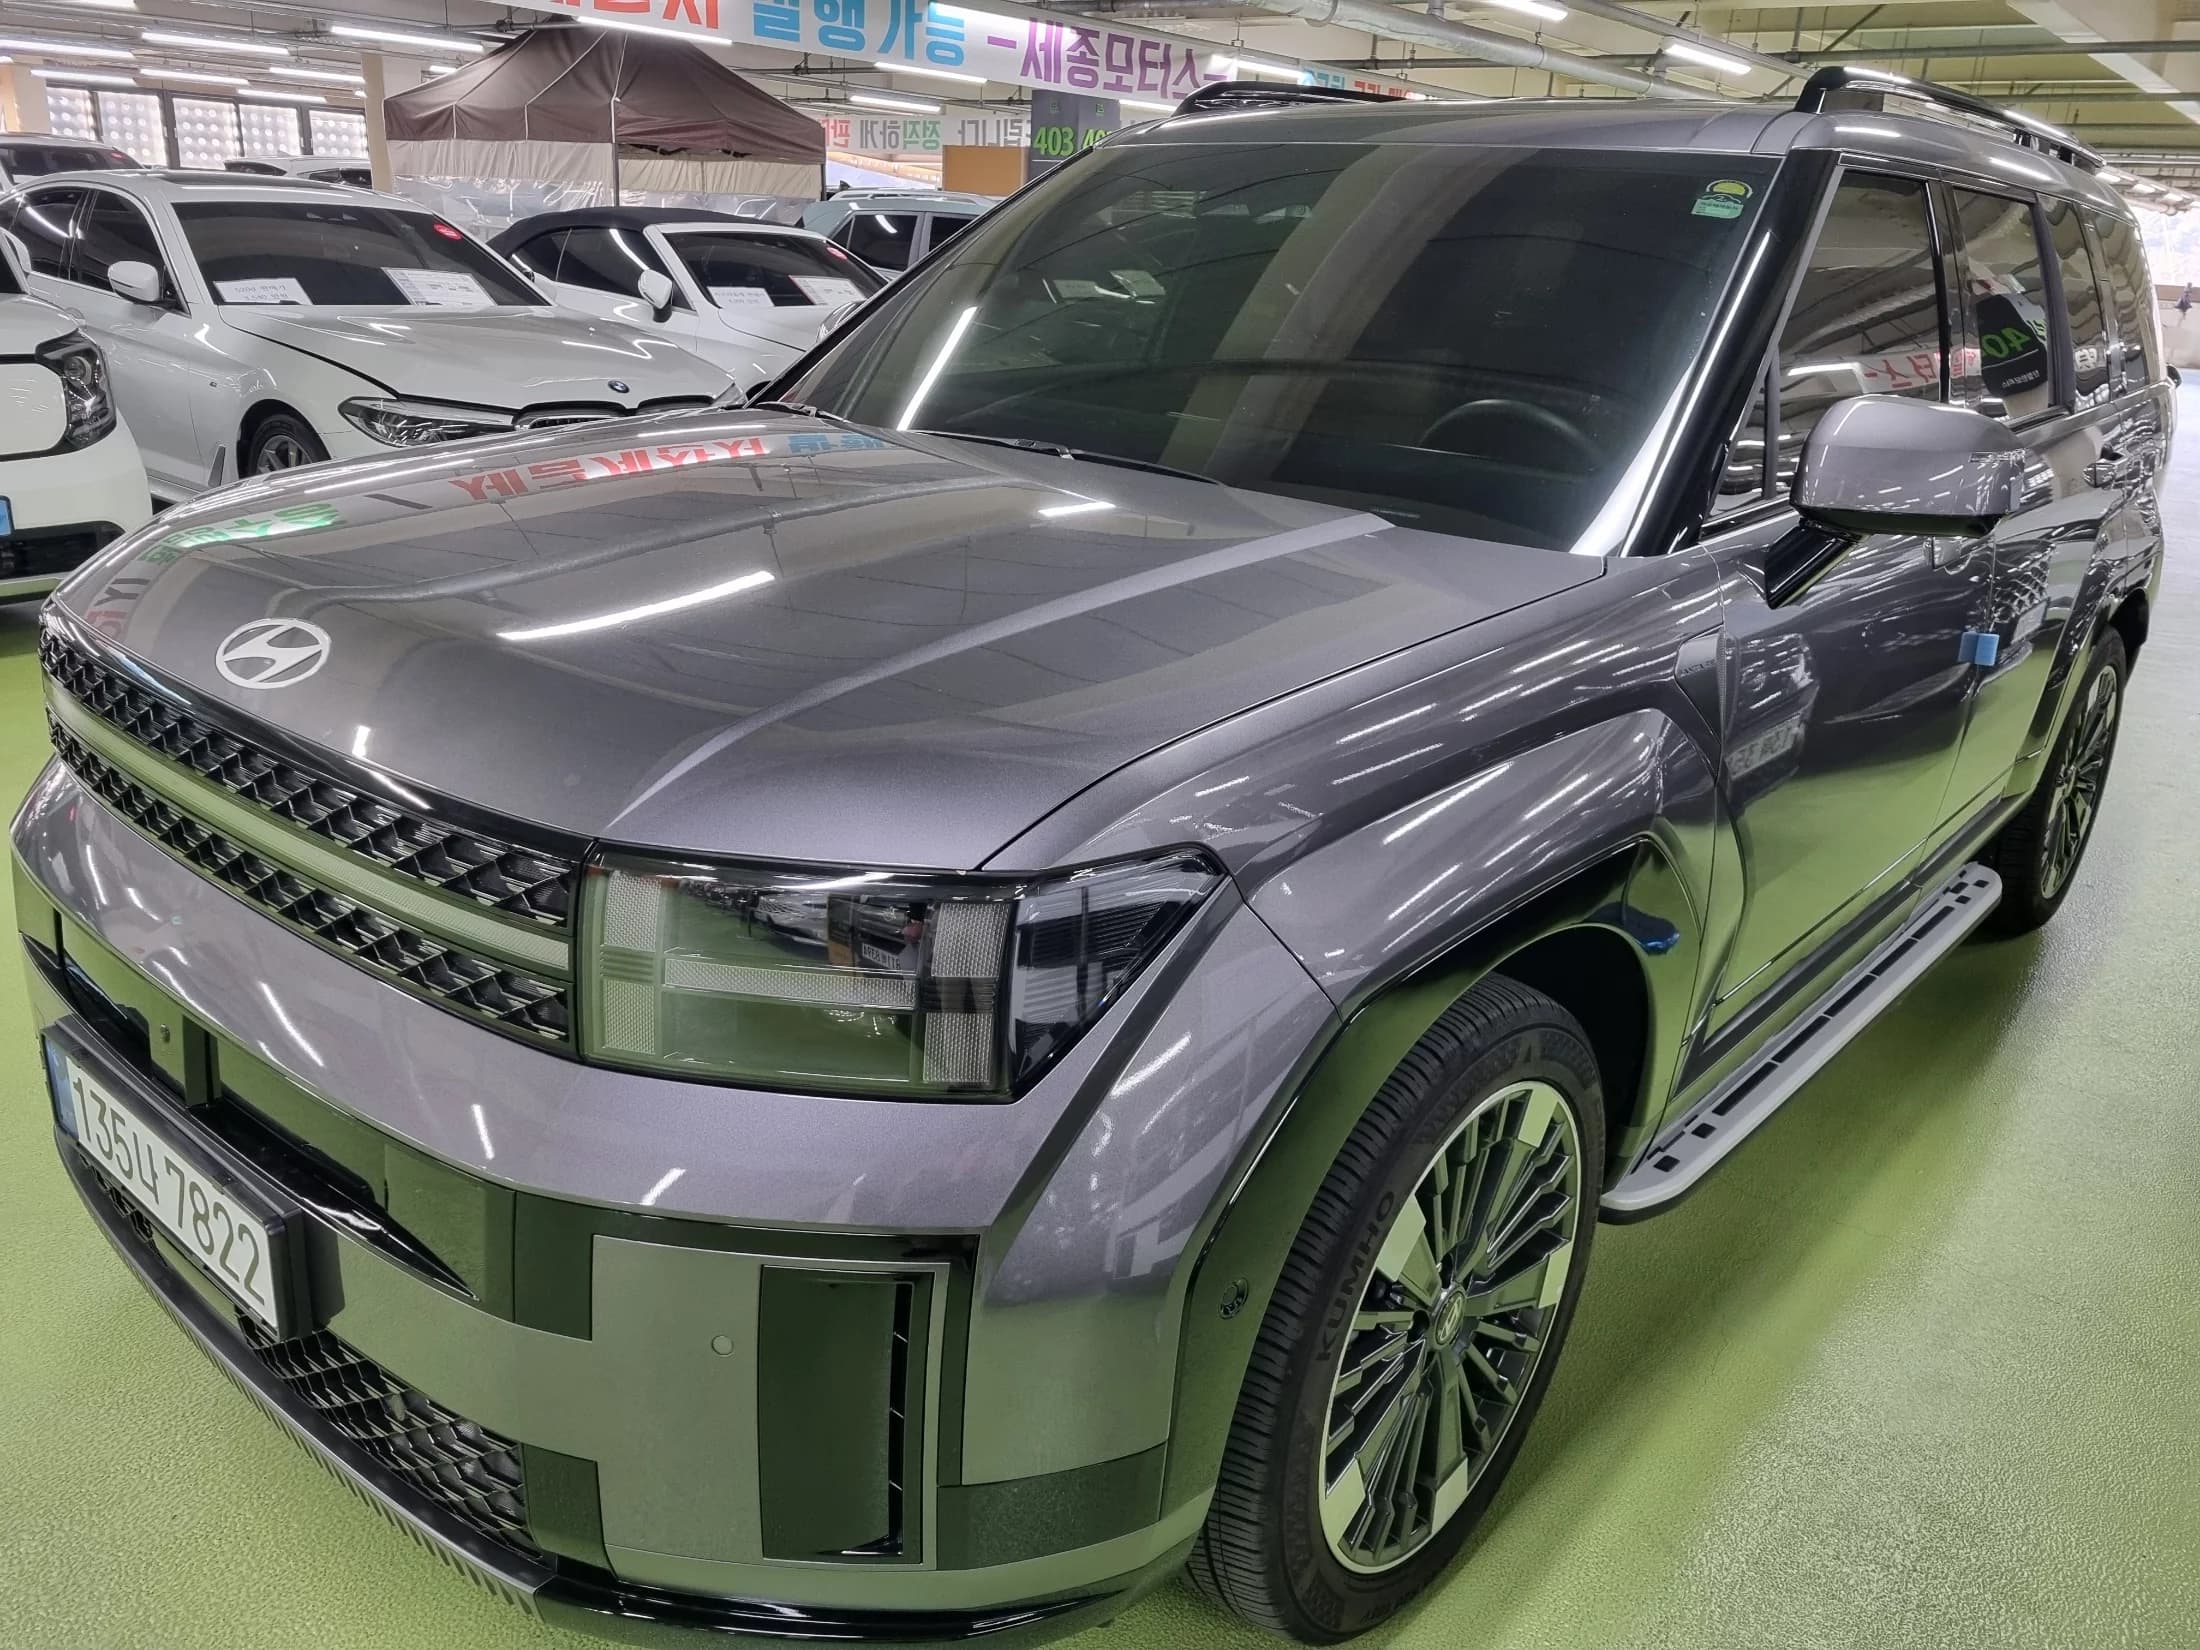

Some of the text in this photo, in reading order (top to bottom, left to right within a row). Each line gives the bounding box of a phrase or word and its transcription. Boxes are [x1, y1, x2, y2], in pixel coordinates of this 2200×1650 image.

[1032, 126, 1074, 156] 403
[165, 1155, 266, 1306] 7822
[1315, 1191, 1395, 1361] KUMHO
